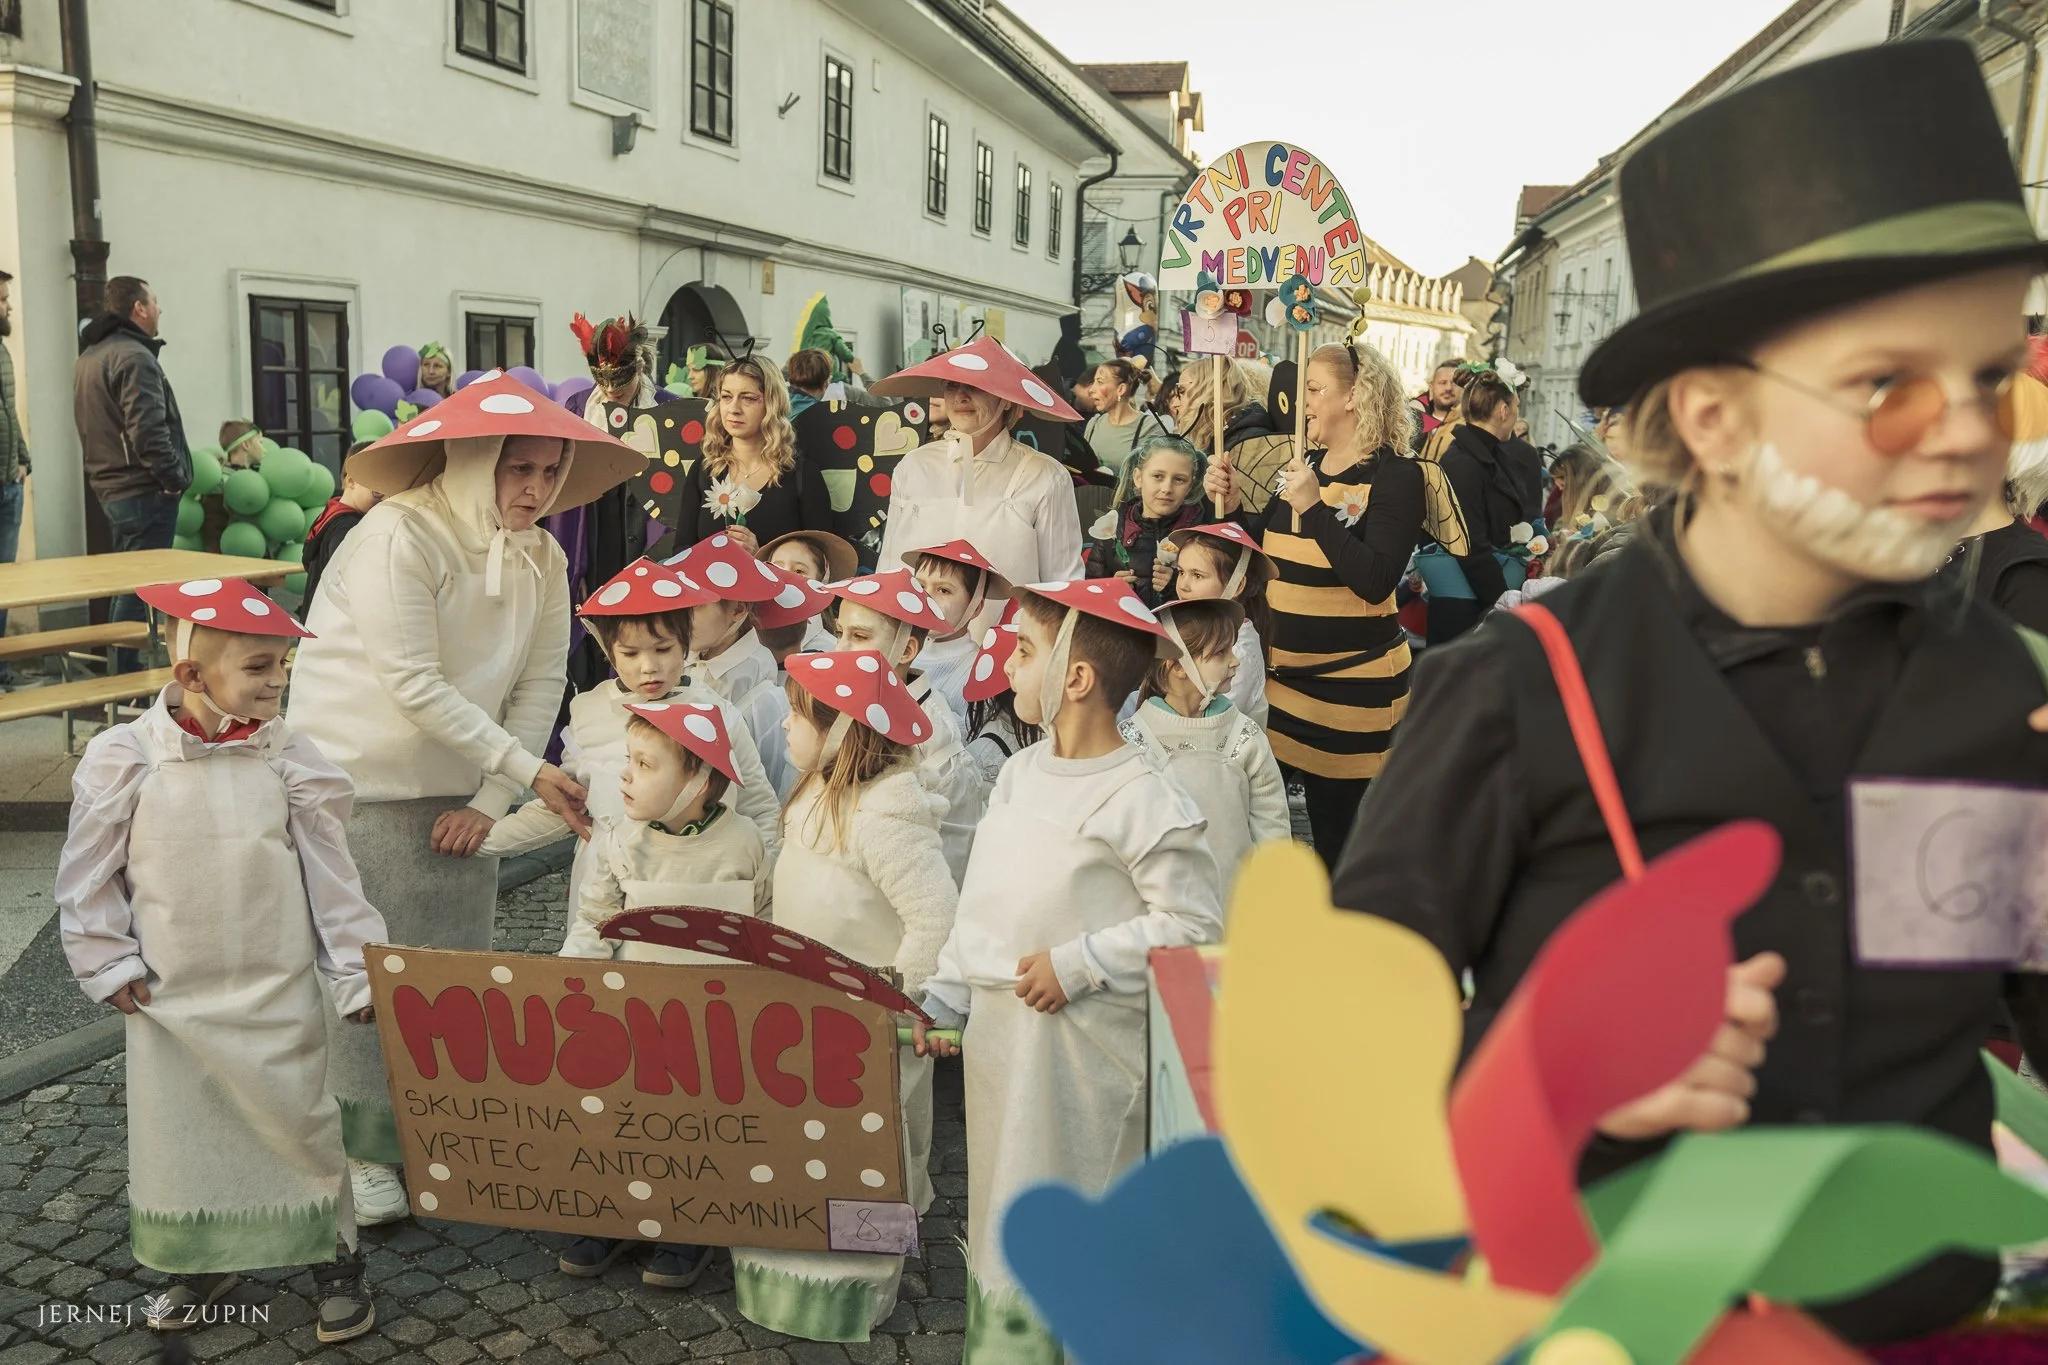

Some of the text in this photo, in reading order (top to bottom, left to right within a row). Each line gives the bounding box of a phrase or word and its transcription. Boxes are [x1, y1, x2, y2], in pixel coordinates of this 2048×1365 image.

[1161, 144, 1364, 286] VRTNI CENTER
[1223, 190, 1282, 241] PRI
[1201, 244, 1326, 286] MEDVEDU
[1237, 342, 1257, 358] OP
[1915, 807, 1990, 924] 6
[414, 1128, 725, 1181] VRTEC ANTONA
[466, 1178, 624, 1220] MEDVEDA
[856, 1208, 882, 1242] 8
